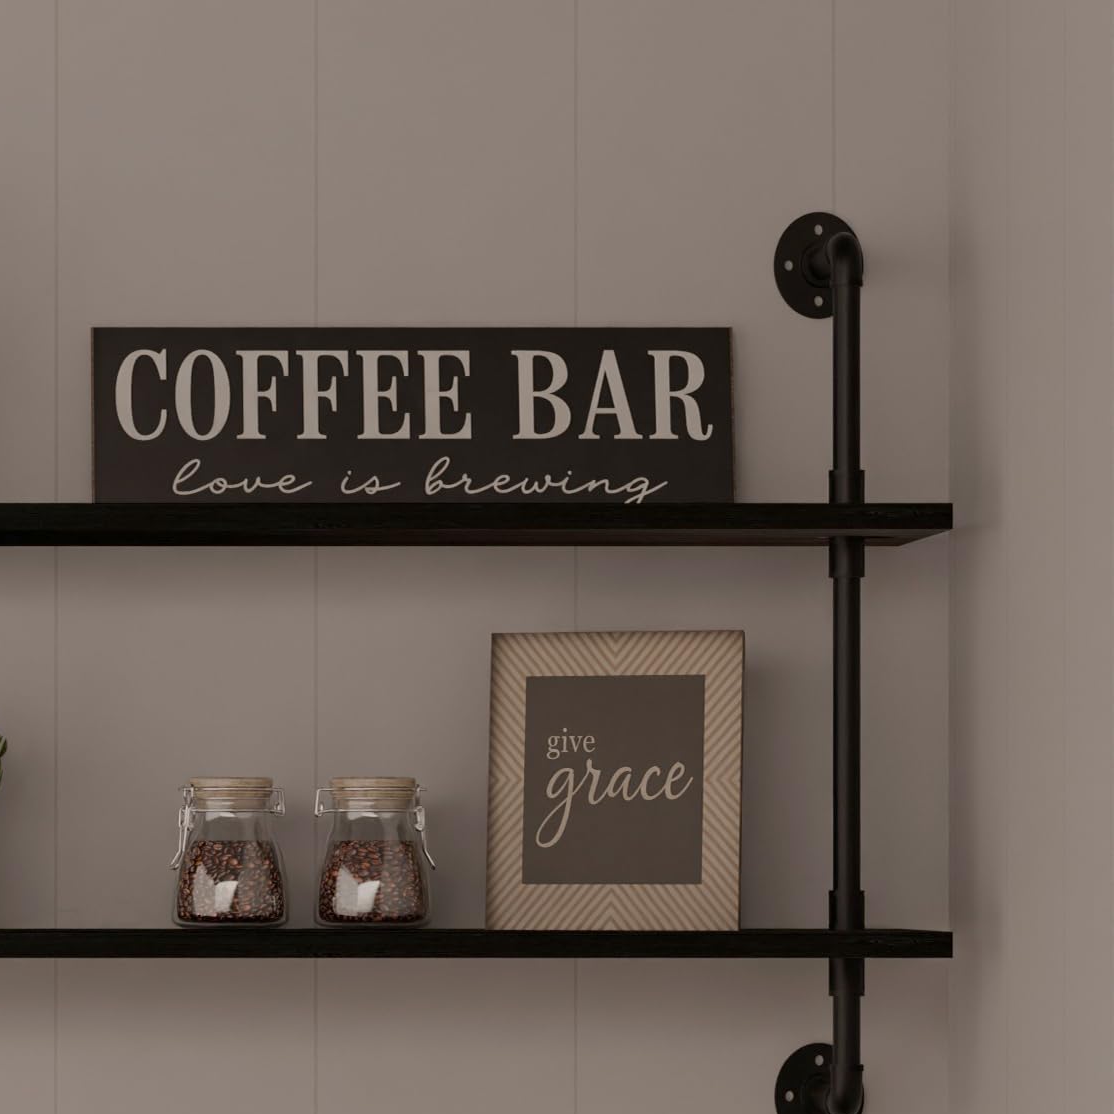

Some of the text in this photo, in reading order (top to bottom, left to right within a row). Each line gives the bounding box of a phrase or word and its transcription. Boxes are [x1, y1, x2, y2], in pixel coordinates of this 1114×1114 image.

[114, 348, 714, 442] COFFEE BAR
[172, 456, 669, 503] love is brewing
[546, 727, 596, 760] give
[536, 758, 694, 848] grace
